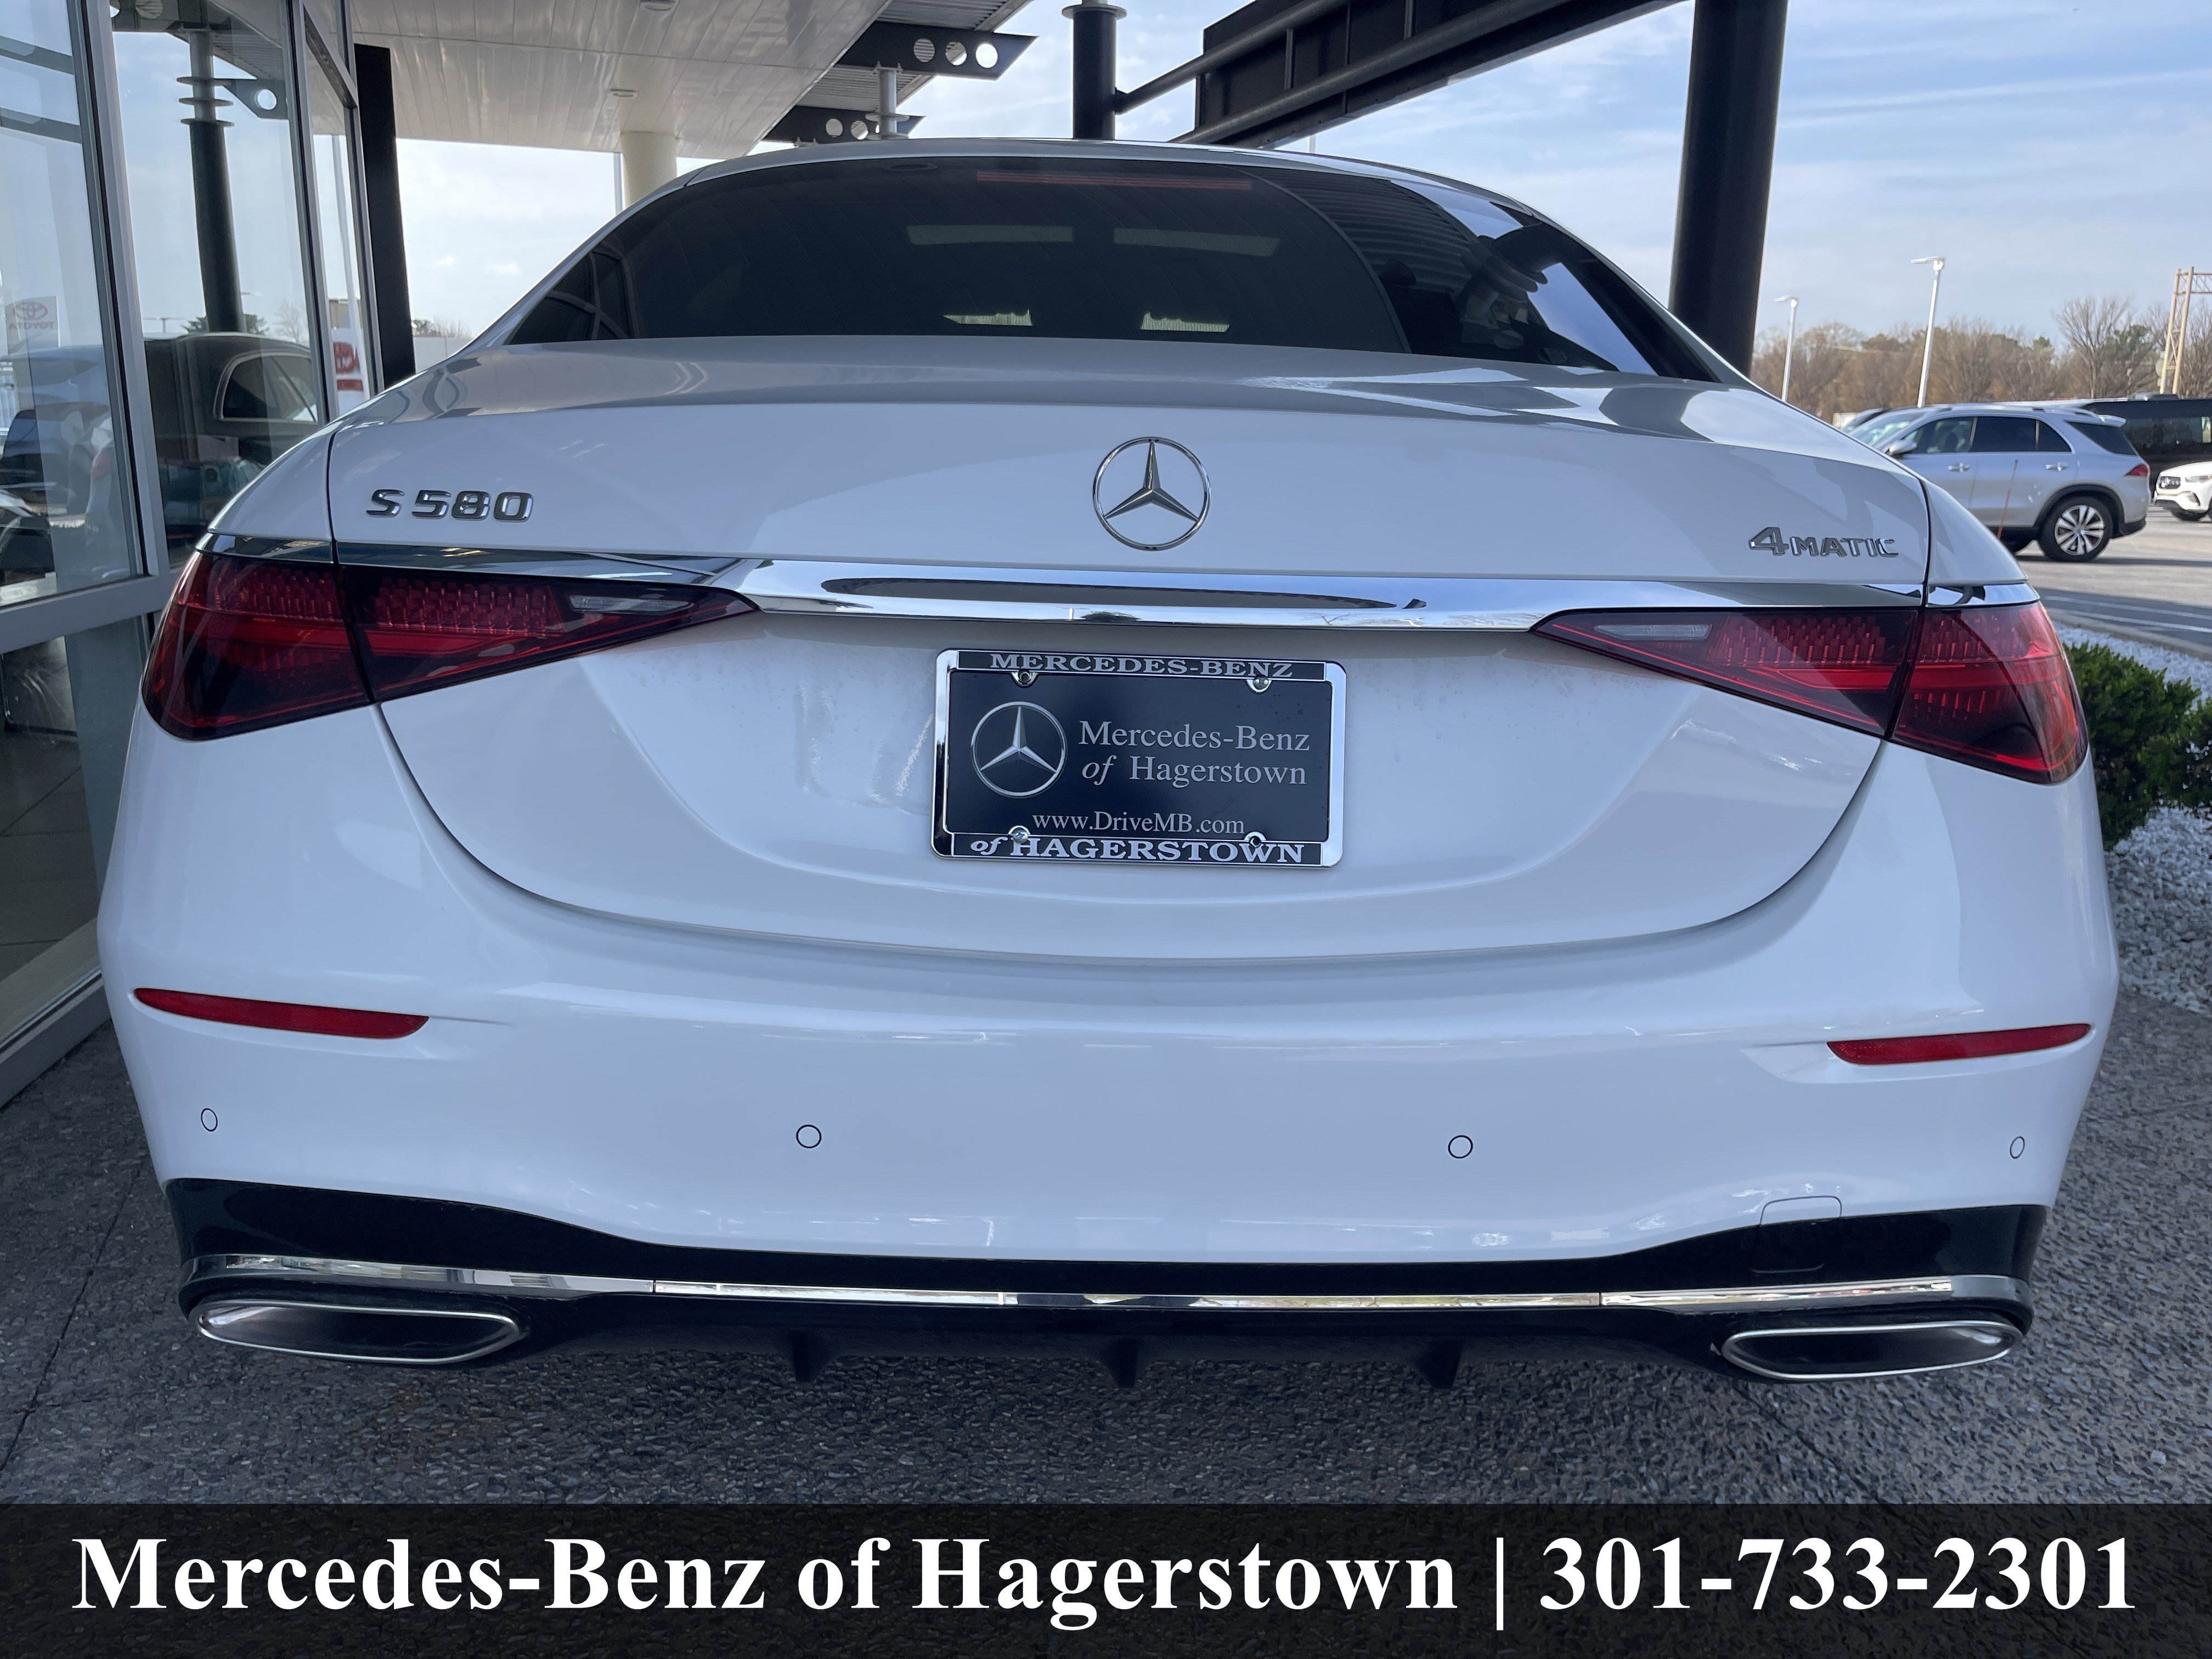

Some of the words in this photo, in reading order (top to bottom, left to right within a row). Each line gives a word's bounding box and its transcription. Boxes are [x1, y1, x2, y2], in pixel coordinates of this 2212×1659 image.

[366, 488, 405, 518] S
[411, 489, 534, 522] 580
[1749, 526, 1899, 557] 4MATIC
[990, 653, 1293, 678] MERCEDES-BENZ
[1078, 720, 1311, 752] Mercedes-Benz
[1082, 754, 1118, 786] of
[1129, 755, 1307, 788] Hagerstown
[1032, 811, 1245, 835] www.DriveMB.com
[970, 836, 1009, 856] of
[1009, 837, 1305, 864] HAGERSTOWN
